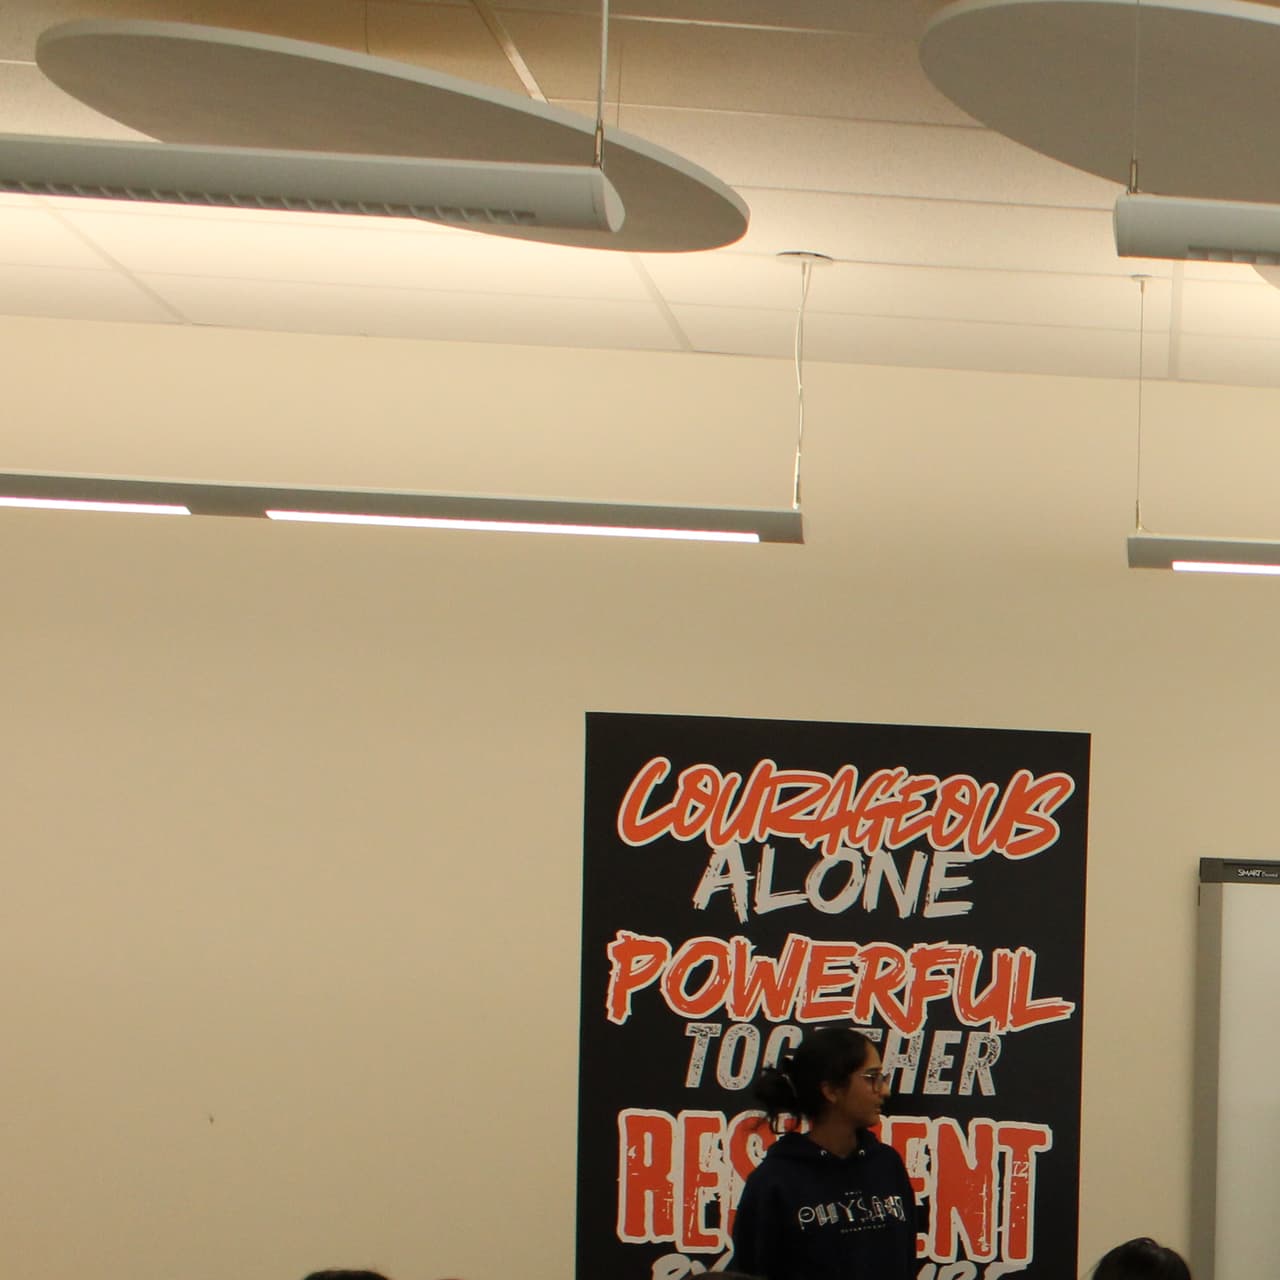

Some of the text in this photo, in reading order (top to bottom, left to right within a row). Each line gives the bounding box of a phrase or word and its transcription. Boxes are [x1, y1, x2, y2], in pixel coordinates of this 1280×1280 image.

[618, 757, 1075, 860] COURAGEOUS
[692, 842, 974, 924] ALONE
[607, 930, 1076, 1034] POWERFUL
[685, 1022, 1001, 1096] TOGHER
[617, 1108, 1053, 1264] RESENT
